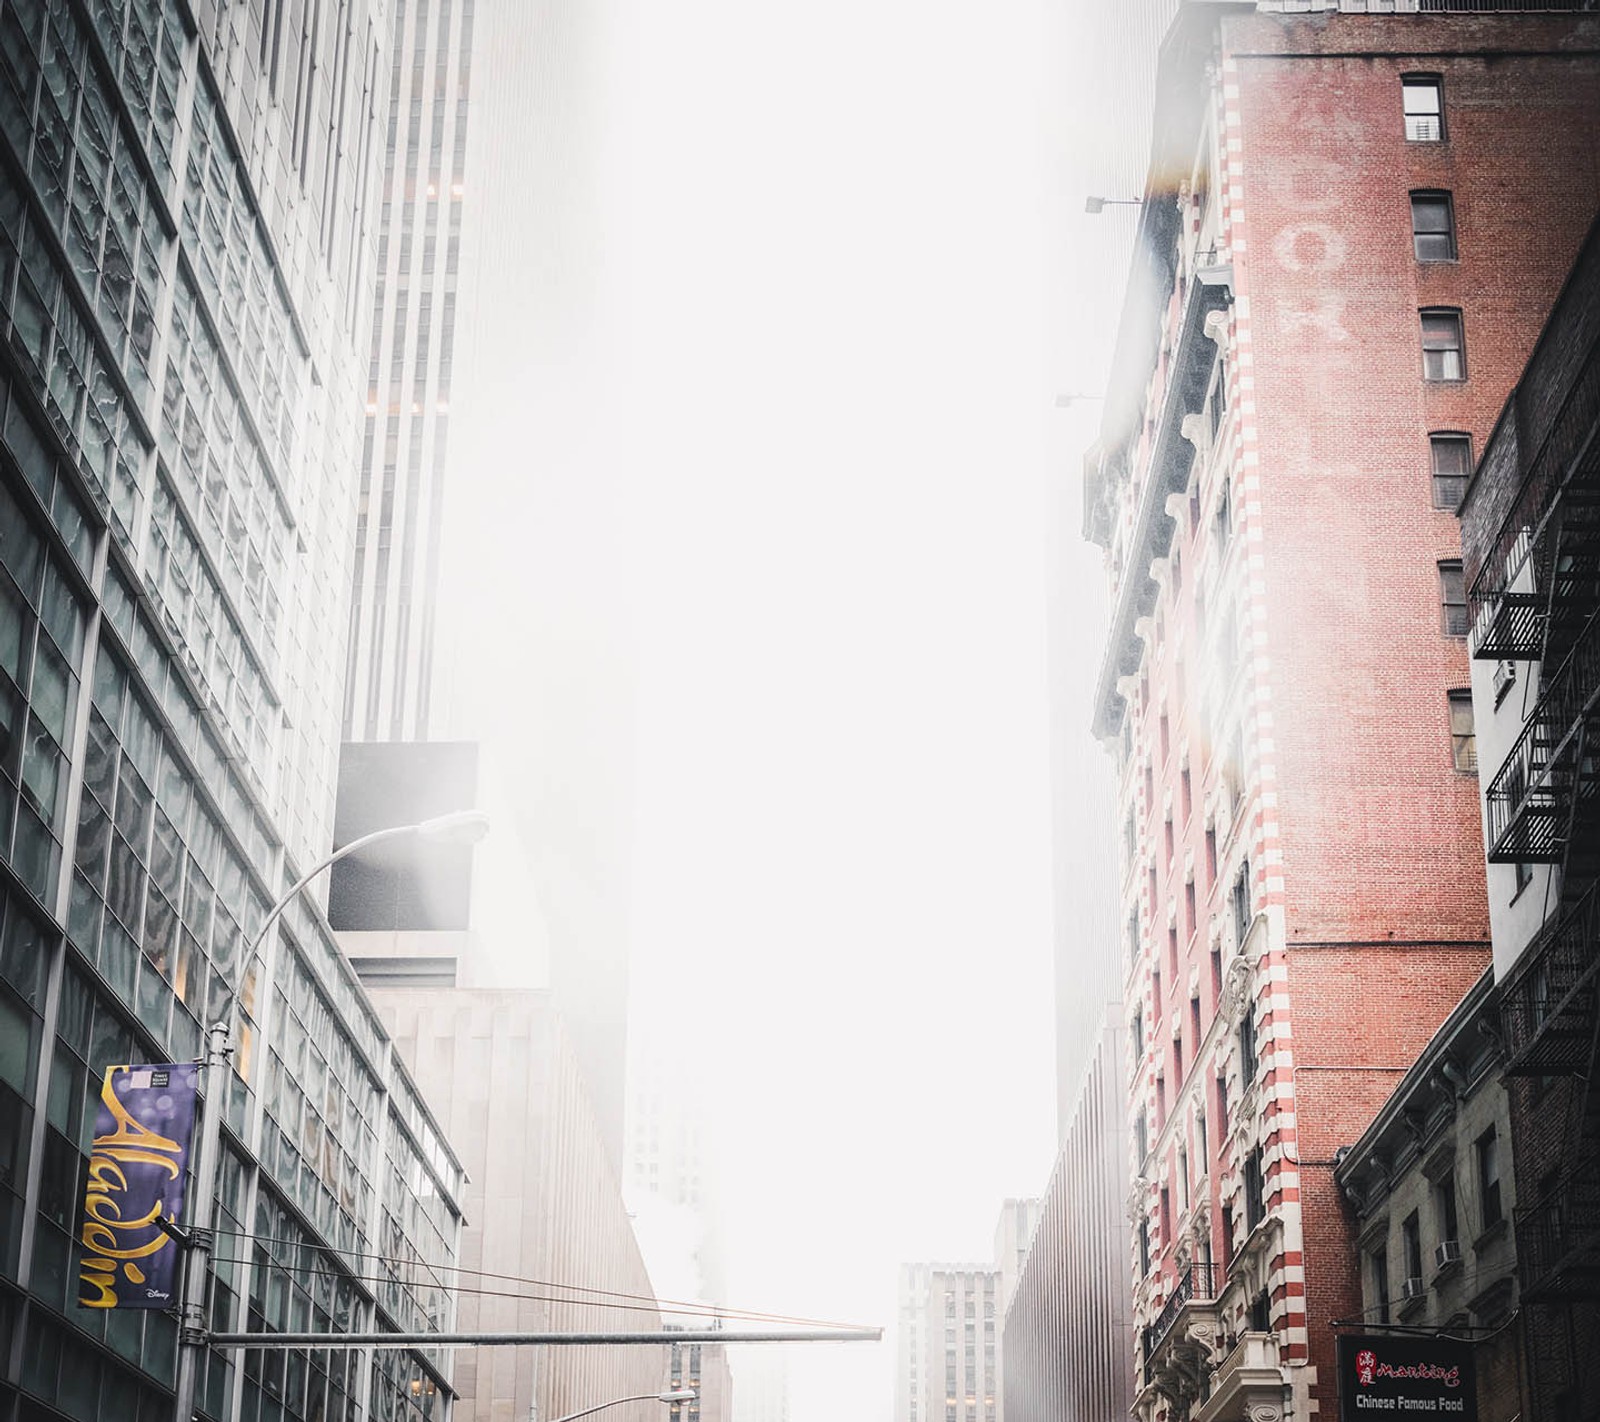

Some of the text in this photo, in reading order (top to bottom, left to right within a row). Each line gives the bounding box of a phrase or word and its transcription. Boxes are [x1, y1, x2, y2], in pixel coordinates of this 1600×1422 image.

[145, 1288, 170, 1301] Disney
[1356, 1394, 1464, 1412] Chinese Famous Food
